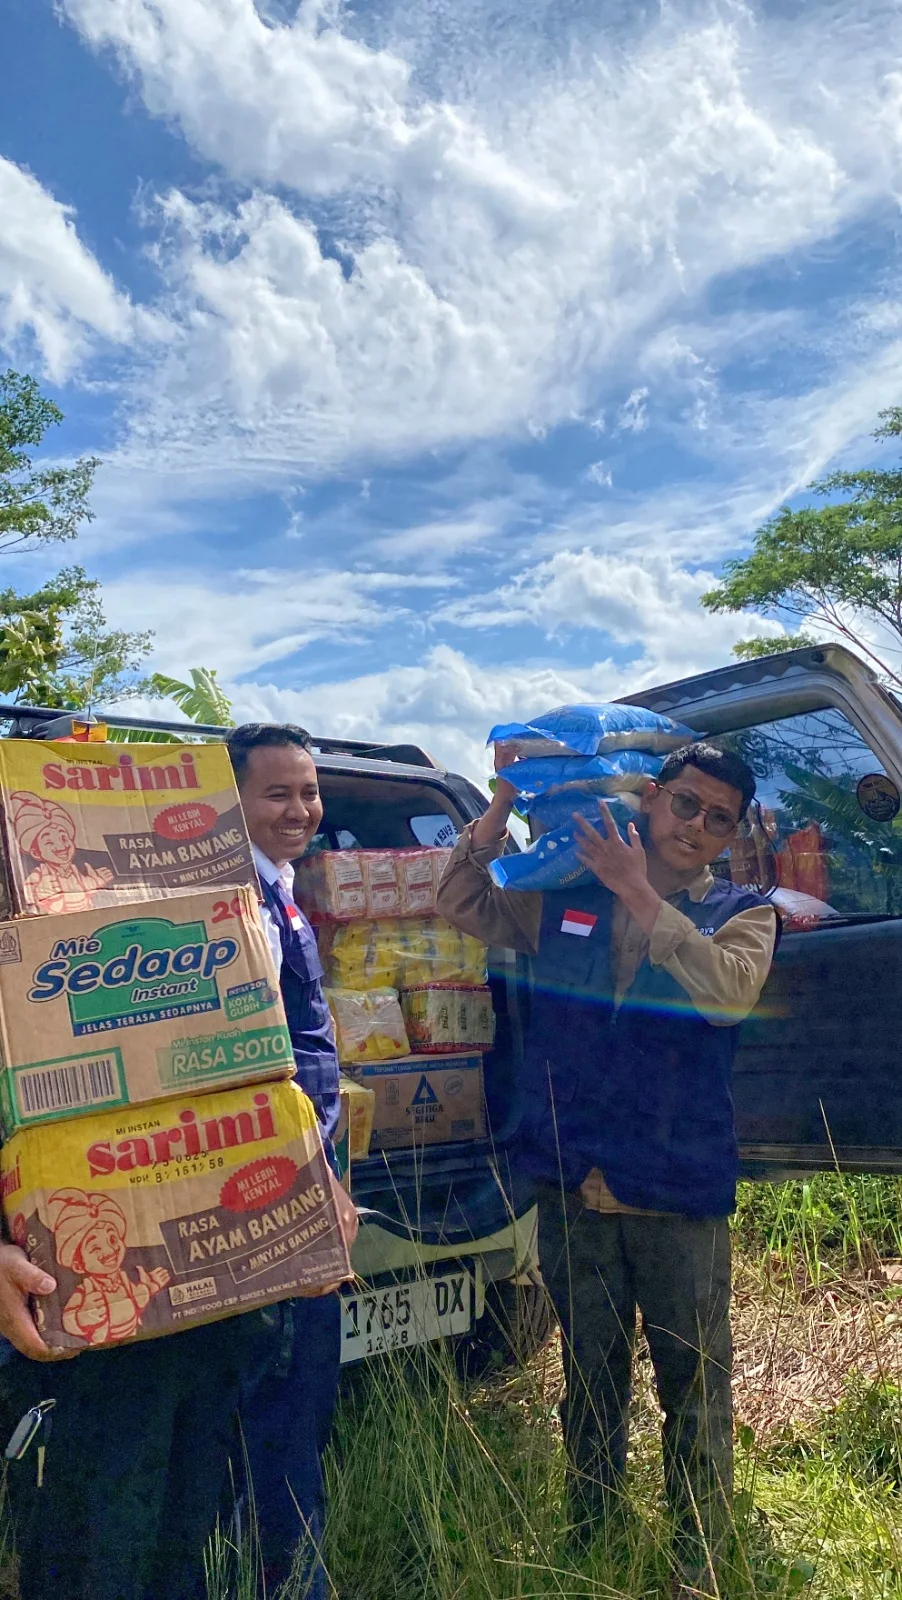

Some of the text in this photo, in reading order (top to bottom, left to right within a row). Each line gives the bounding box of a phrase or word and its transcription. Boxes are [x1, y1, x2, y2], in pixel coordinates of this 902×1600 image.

[42, 753, 201, 791] sarimi
[167, 809, 201, 825] MI LEBIH
[172, 818, 205, 834] KENYAL
[119, 838, 154, 850] RASA
[129, 828, 243, 869] AYAM BAWANG
[180, 869, 211, 884] MINYAK
[213, 855, 245, 872] BAWANG
[52, 938, 100, 960] Mie
[29, 938, 238, 1002] Sedaap
[131, 978, 199, 1004] Instant
[228, 994, 255, 1009] KOYA
[80, 1001, 213, 1034] JELAS TERASA SEDAPNYA
[230, 1002, 260, 1017] GURIH
[173, 1034, 287, 1076] RASA SOTO
[86, 1092, 277, 1179] sarimi
[128, 1120, 161, 1133] INSTAN
[236, 1166, 277, 1192] MI LEBIH
[242, 1180, 282, 1203] KENYAL
[178, 1215, 220, 1238] RASA
[189, 1183, 325, 1262] AYAM BAWANG
[249, 1242, 288, 1270] MINYAK
[288, 1217, 329, 1249] BAWANG
[186, 1281, 214, 1293] HALAL
[345, 1278, 464, 1339] 1765 DX
